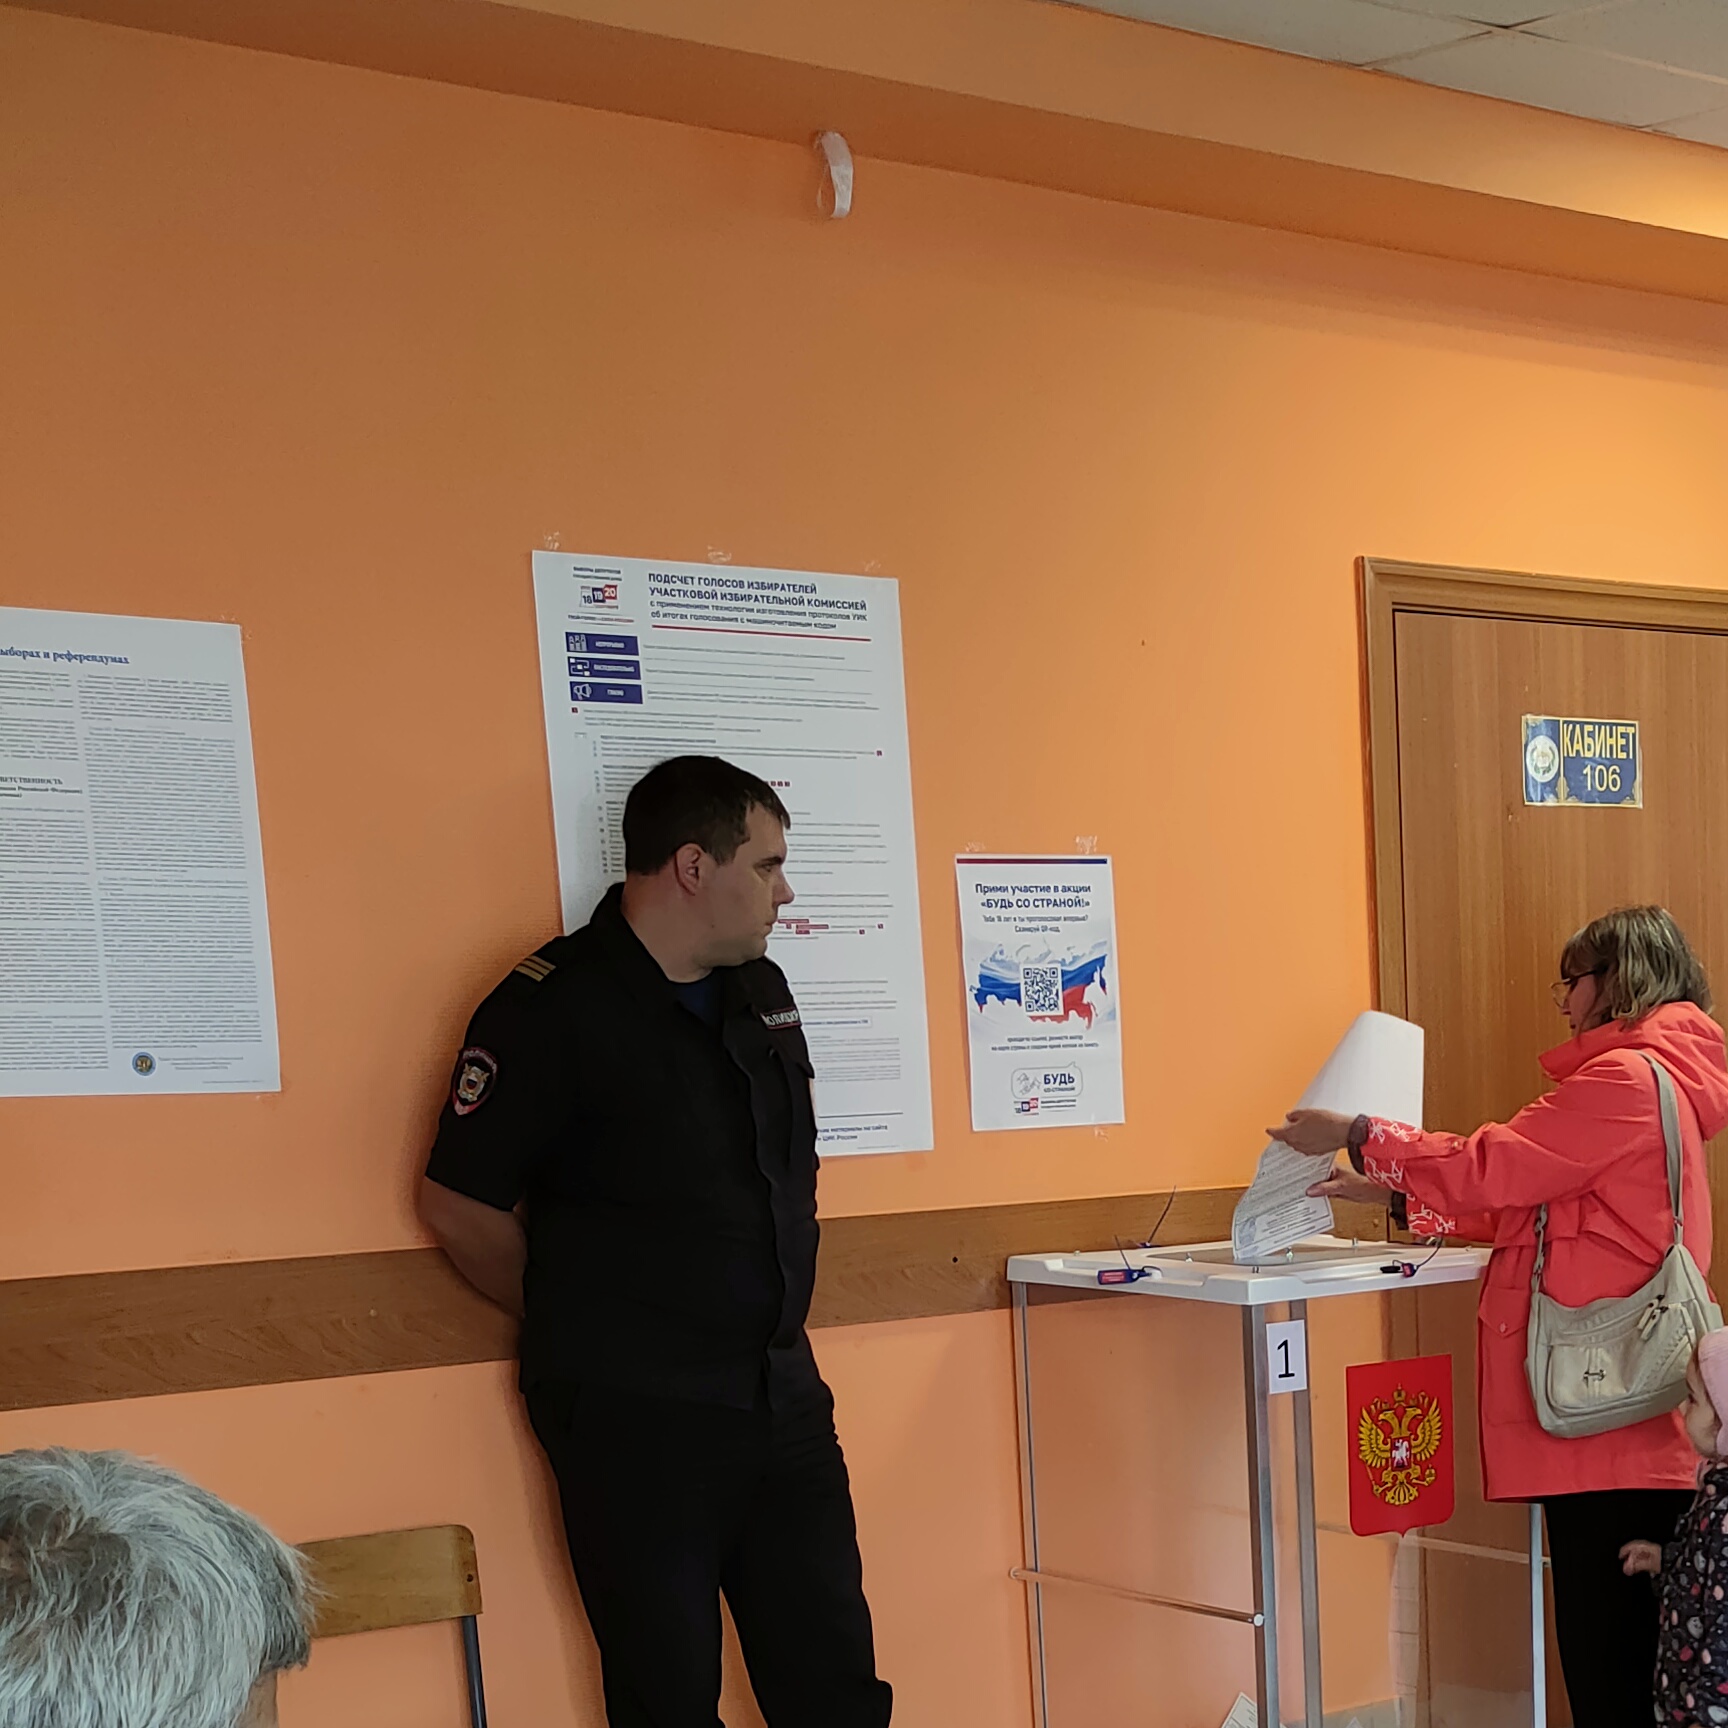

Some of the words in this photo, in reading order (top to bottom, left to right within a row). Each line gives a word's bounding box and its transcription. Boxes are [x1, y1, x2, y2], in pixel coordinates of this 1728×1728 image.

[648, 573, 695, 586] ПОДСЧЕТ
[698, 577, 745, 589] ГОЛОСОВ
[747, 580, 817, 594] ИЗБИРАТЕЛЕЙ
[649, 587, 718, 600] УЧАСТКОВОЙ
[720, 592, 805, 606] ИЗБИРАТЕЛЬНОЙ
[807, 598, 867, 611] КОМИССИЕЙ
[0, 646, 40, 660] ыборах
[43, 651, 50, 659] и
[53, 650, 129, 666] референдумах
[1563, 723, 1635, 759] КАБИНЕТ
[1583, 764, 1621, 792] 106
[975, 883, 1009, 895] Прими
[1010, 885, 1051, 896] участие
[1053, 885, 1060, 893] в
[1061, 885, 1091, 894] акции
[981, 898, 1014, 909] «БУДЬ
[1016, 899, 1030, 908] СО
[1032, 896, 1090, 908] СТРАНОЙ!»
[1043, 1073, 1075, 1086] БУДЬ
[1276, 1339, 1295, 1379] 1
